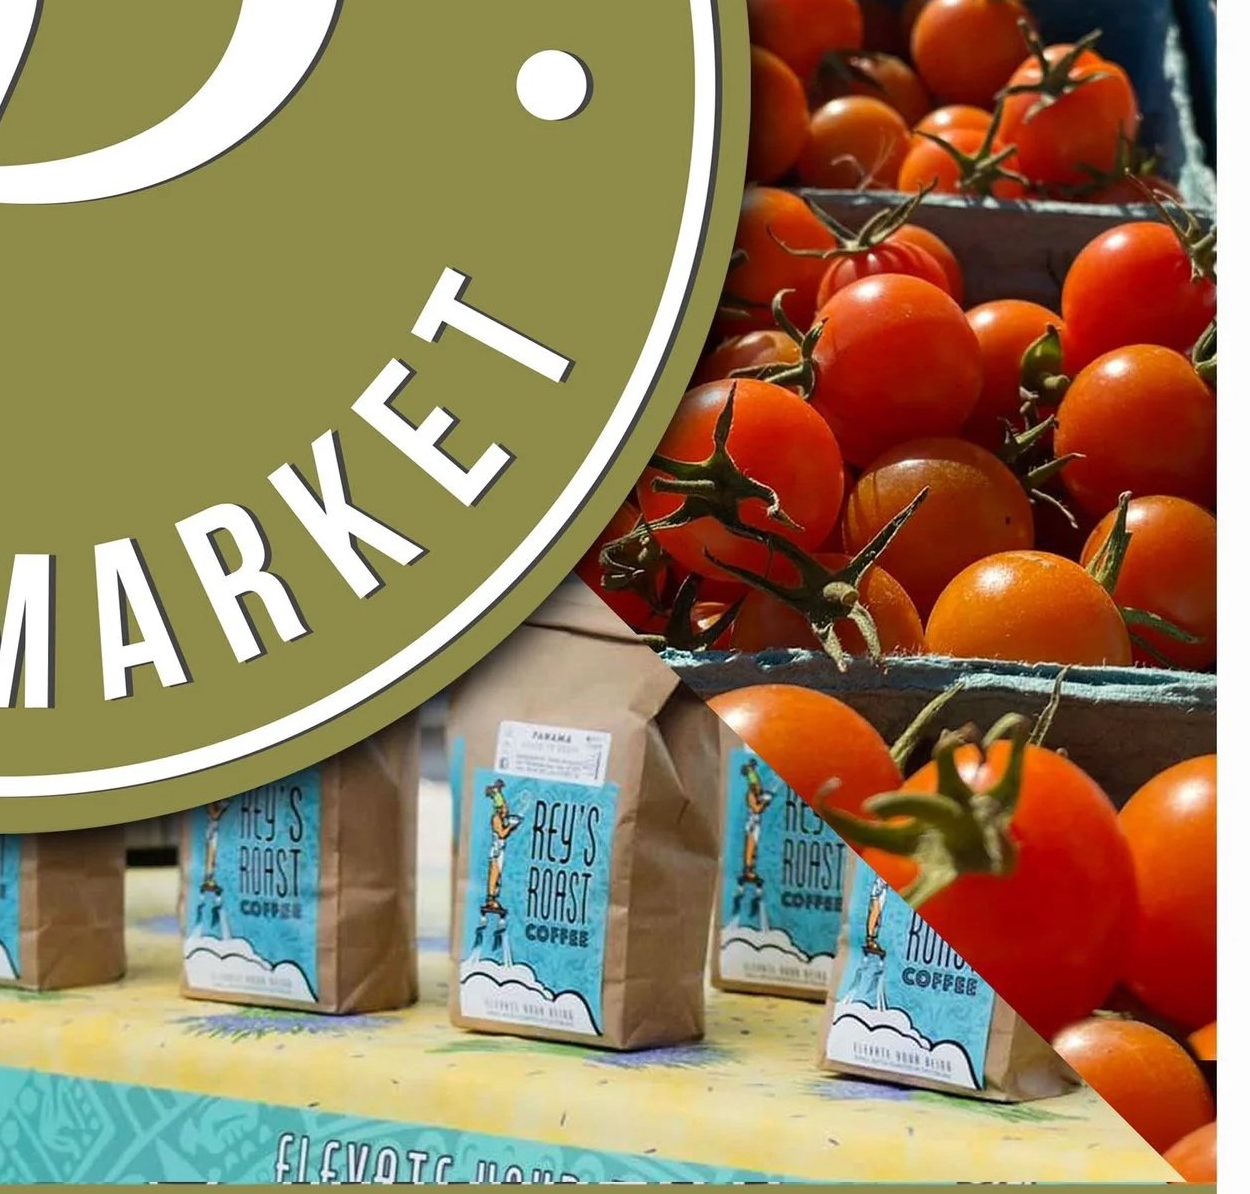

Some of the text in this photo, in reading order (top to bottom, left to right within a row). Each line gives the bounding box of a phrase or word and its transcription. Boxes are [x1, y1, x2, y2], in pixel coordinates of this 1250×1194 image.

[532, 731, 572, 744] PANAMA
[531, 800, 599, 867] REY'S
[239, 845, 302, 898] ROAST
[781, 838, 846, 891] ROAST
[239, 899, 303, 919] COFFEE
[527, 866, 592, 925] ROAST
[781, 891, 843, 913] COFFEE
[525, 923, 589, 949] COFFEE
[902, 967, 978, 997] COFFEE
